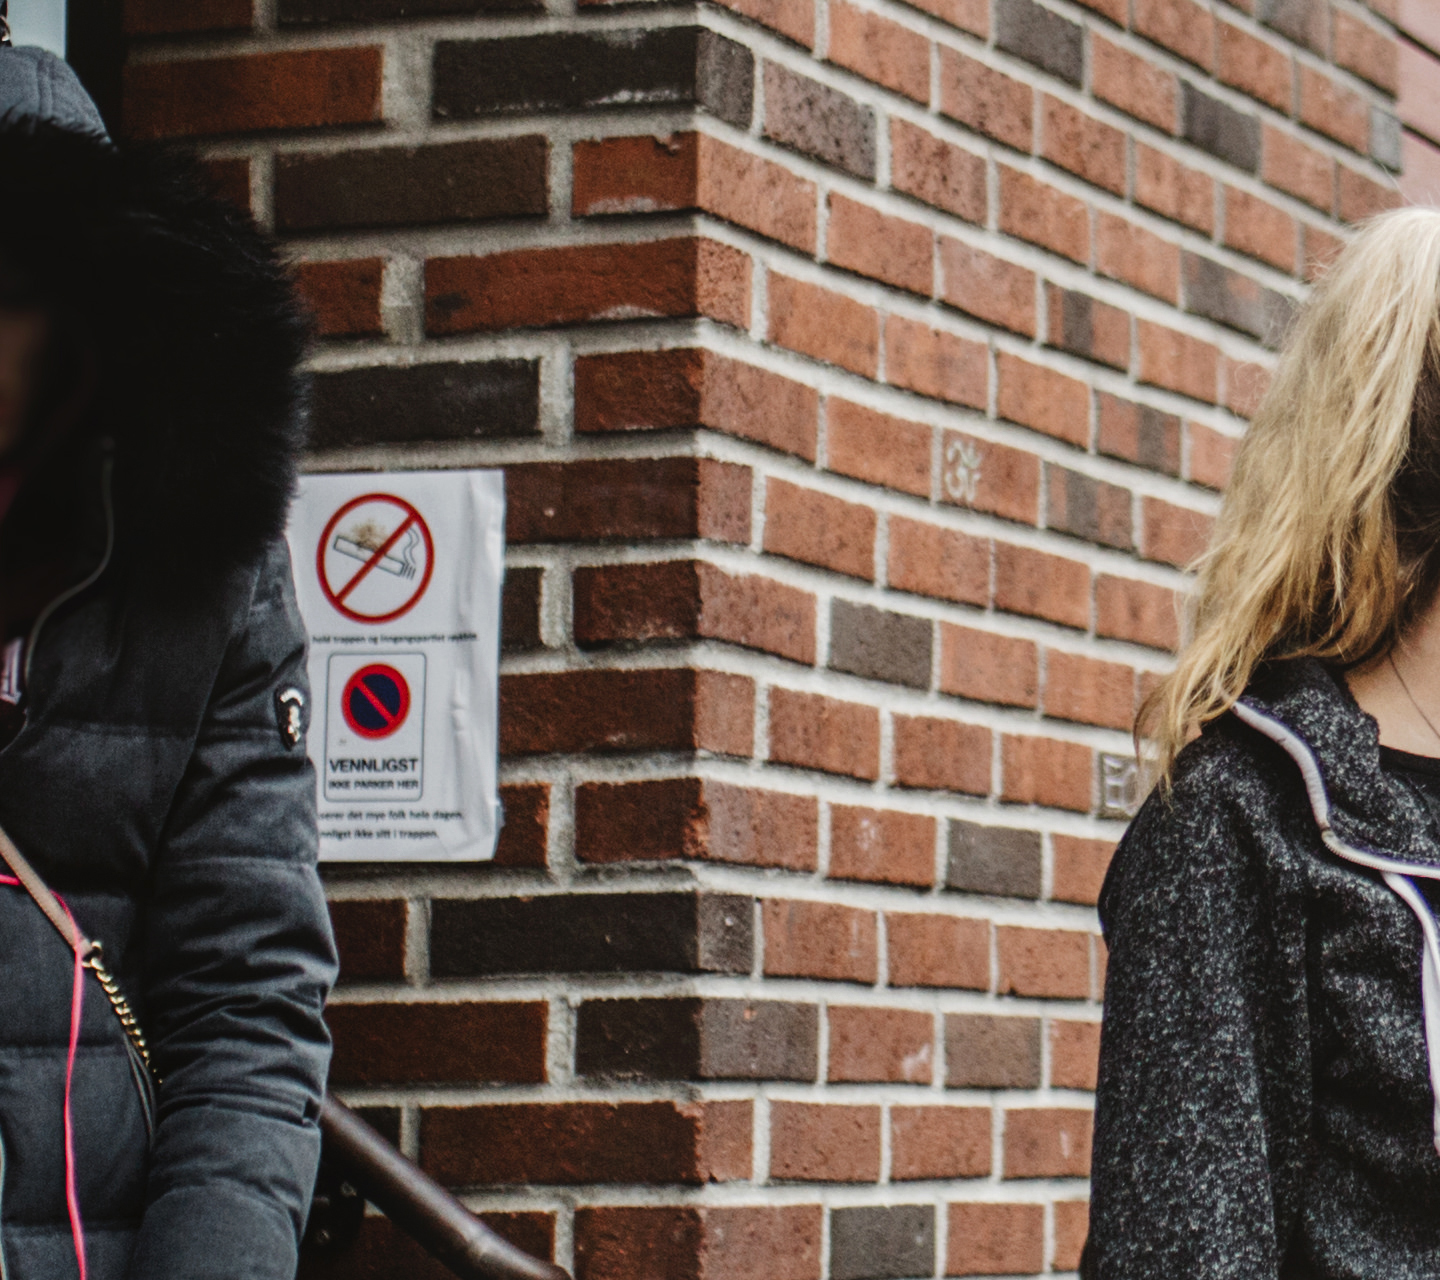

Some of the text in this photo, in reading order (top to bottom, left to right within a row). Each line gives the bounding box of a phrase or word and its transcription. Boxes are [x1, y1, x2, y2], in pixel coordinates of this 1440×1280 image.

[329, 758, 419, 773] VENNLIGST
[328, 779, 419, 790] IKKE PARKER HER
[388, 808, 407, 821] folk
